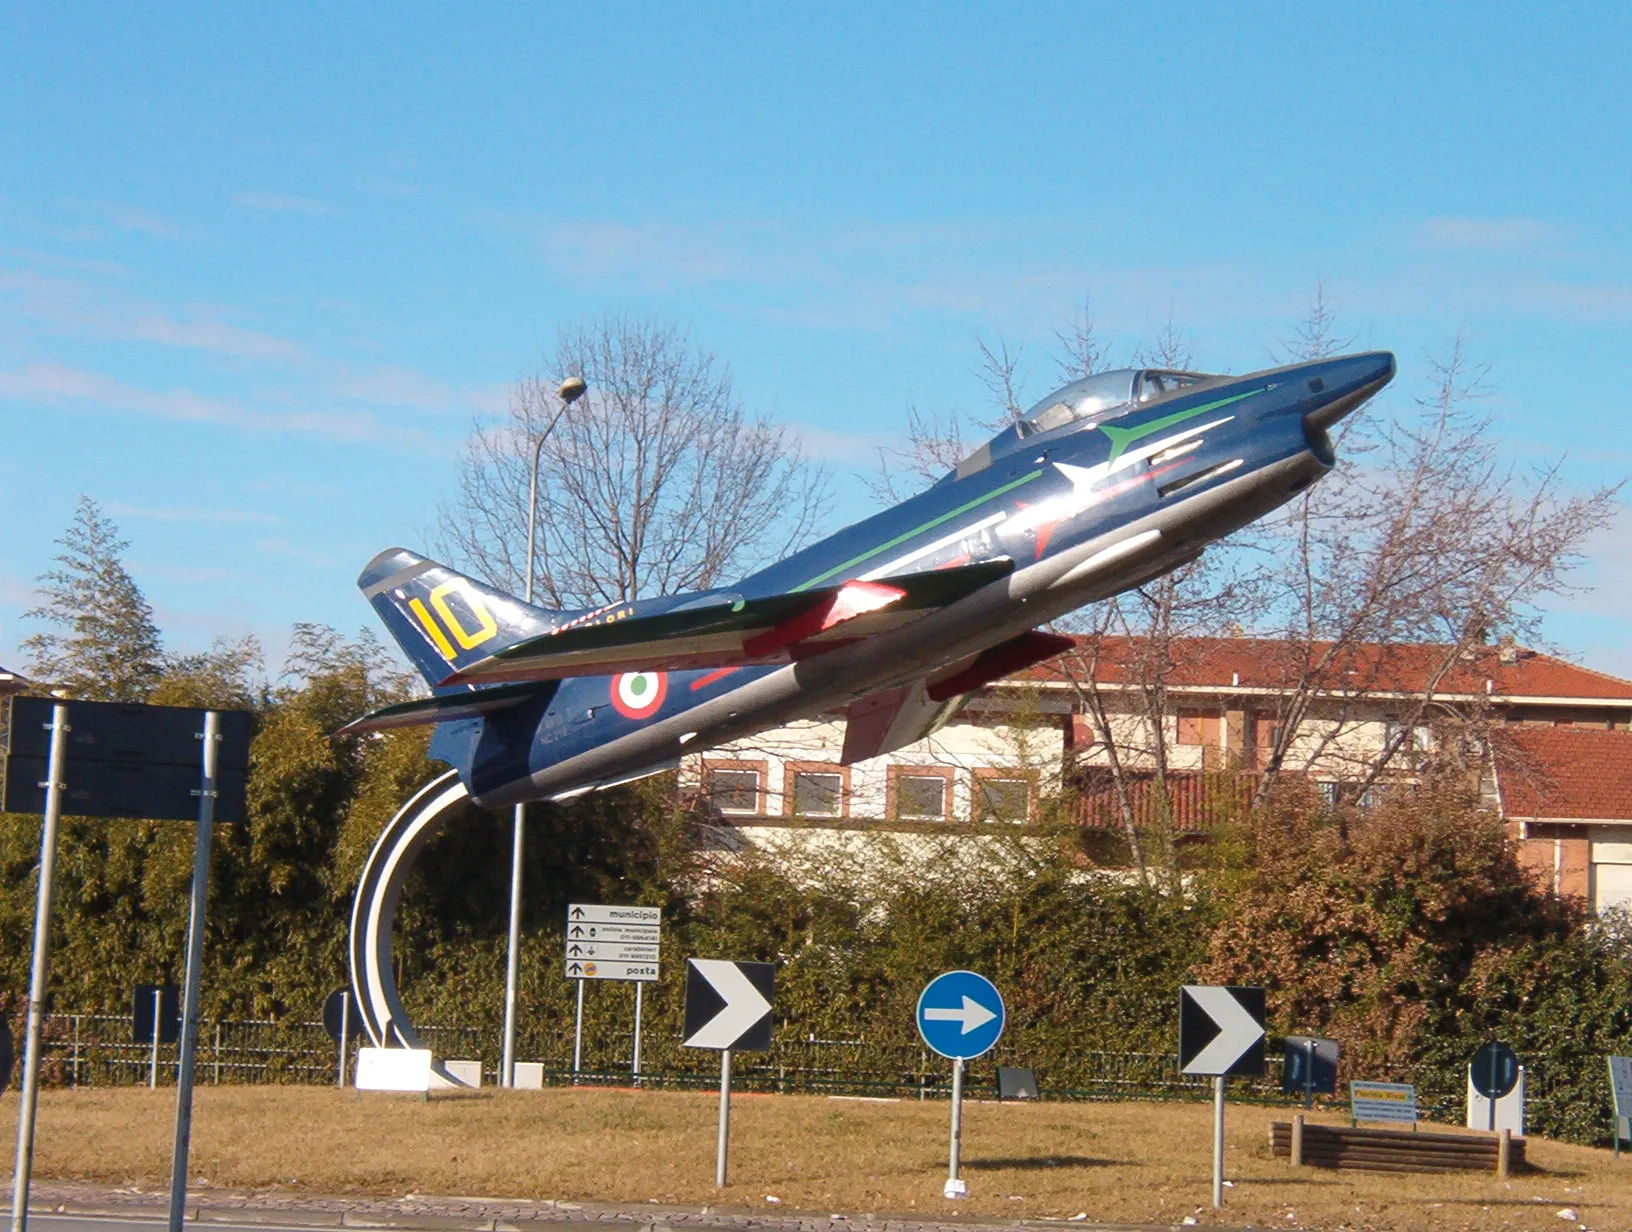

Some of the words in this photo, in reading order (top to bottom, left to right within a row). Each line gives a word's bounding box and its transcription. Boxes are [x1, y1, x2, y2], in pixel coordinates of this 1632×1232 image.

[408, 577, 498, 660] 10
[609, 910, 658, 920] municipio
[627, 967, 656, 975] posta
